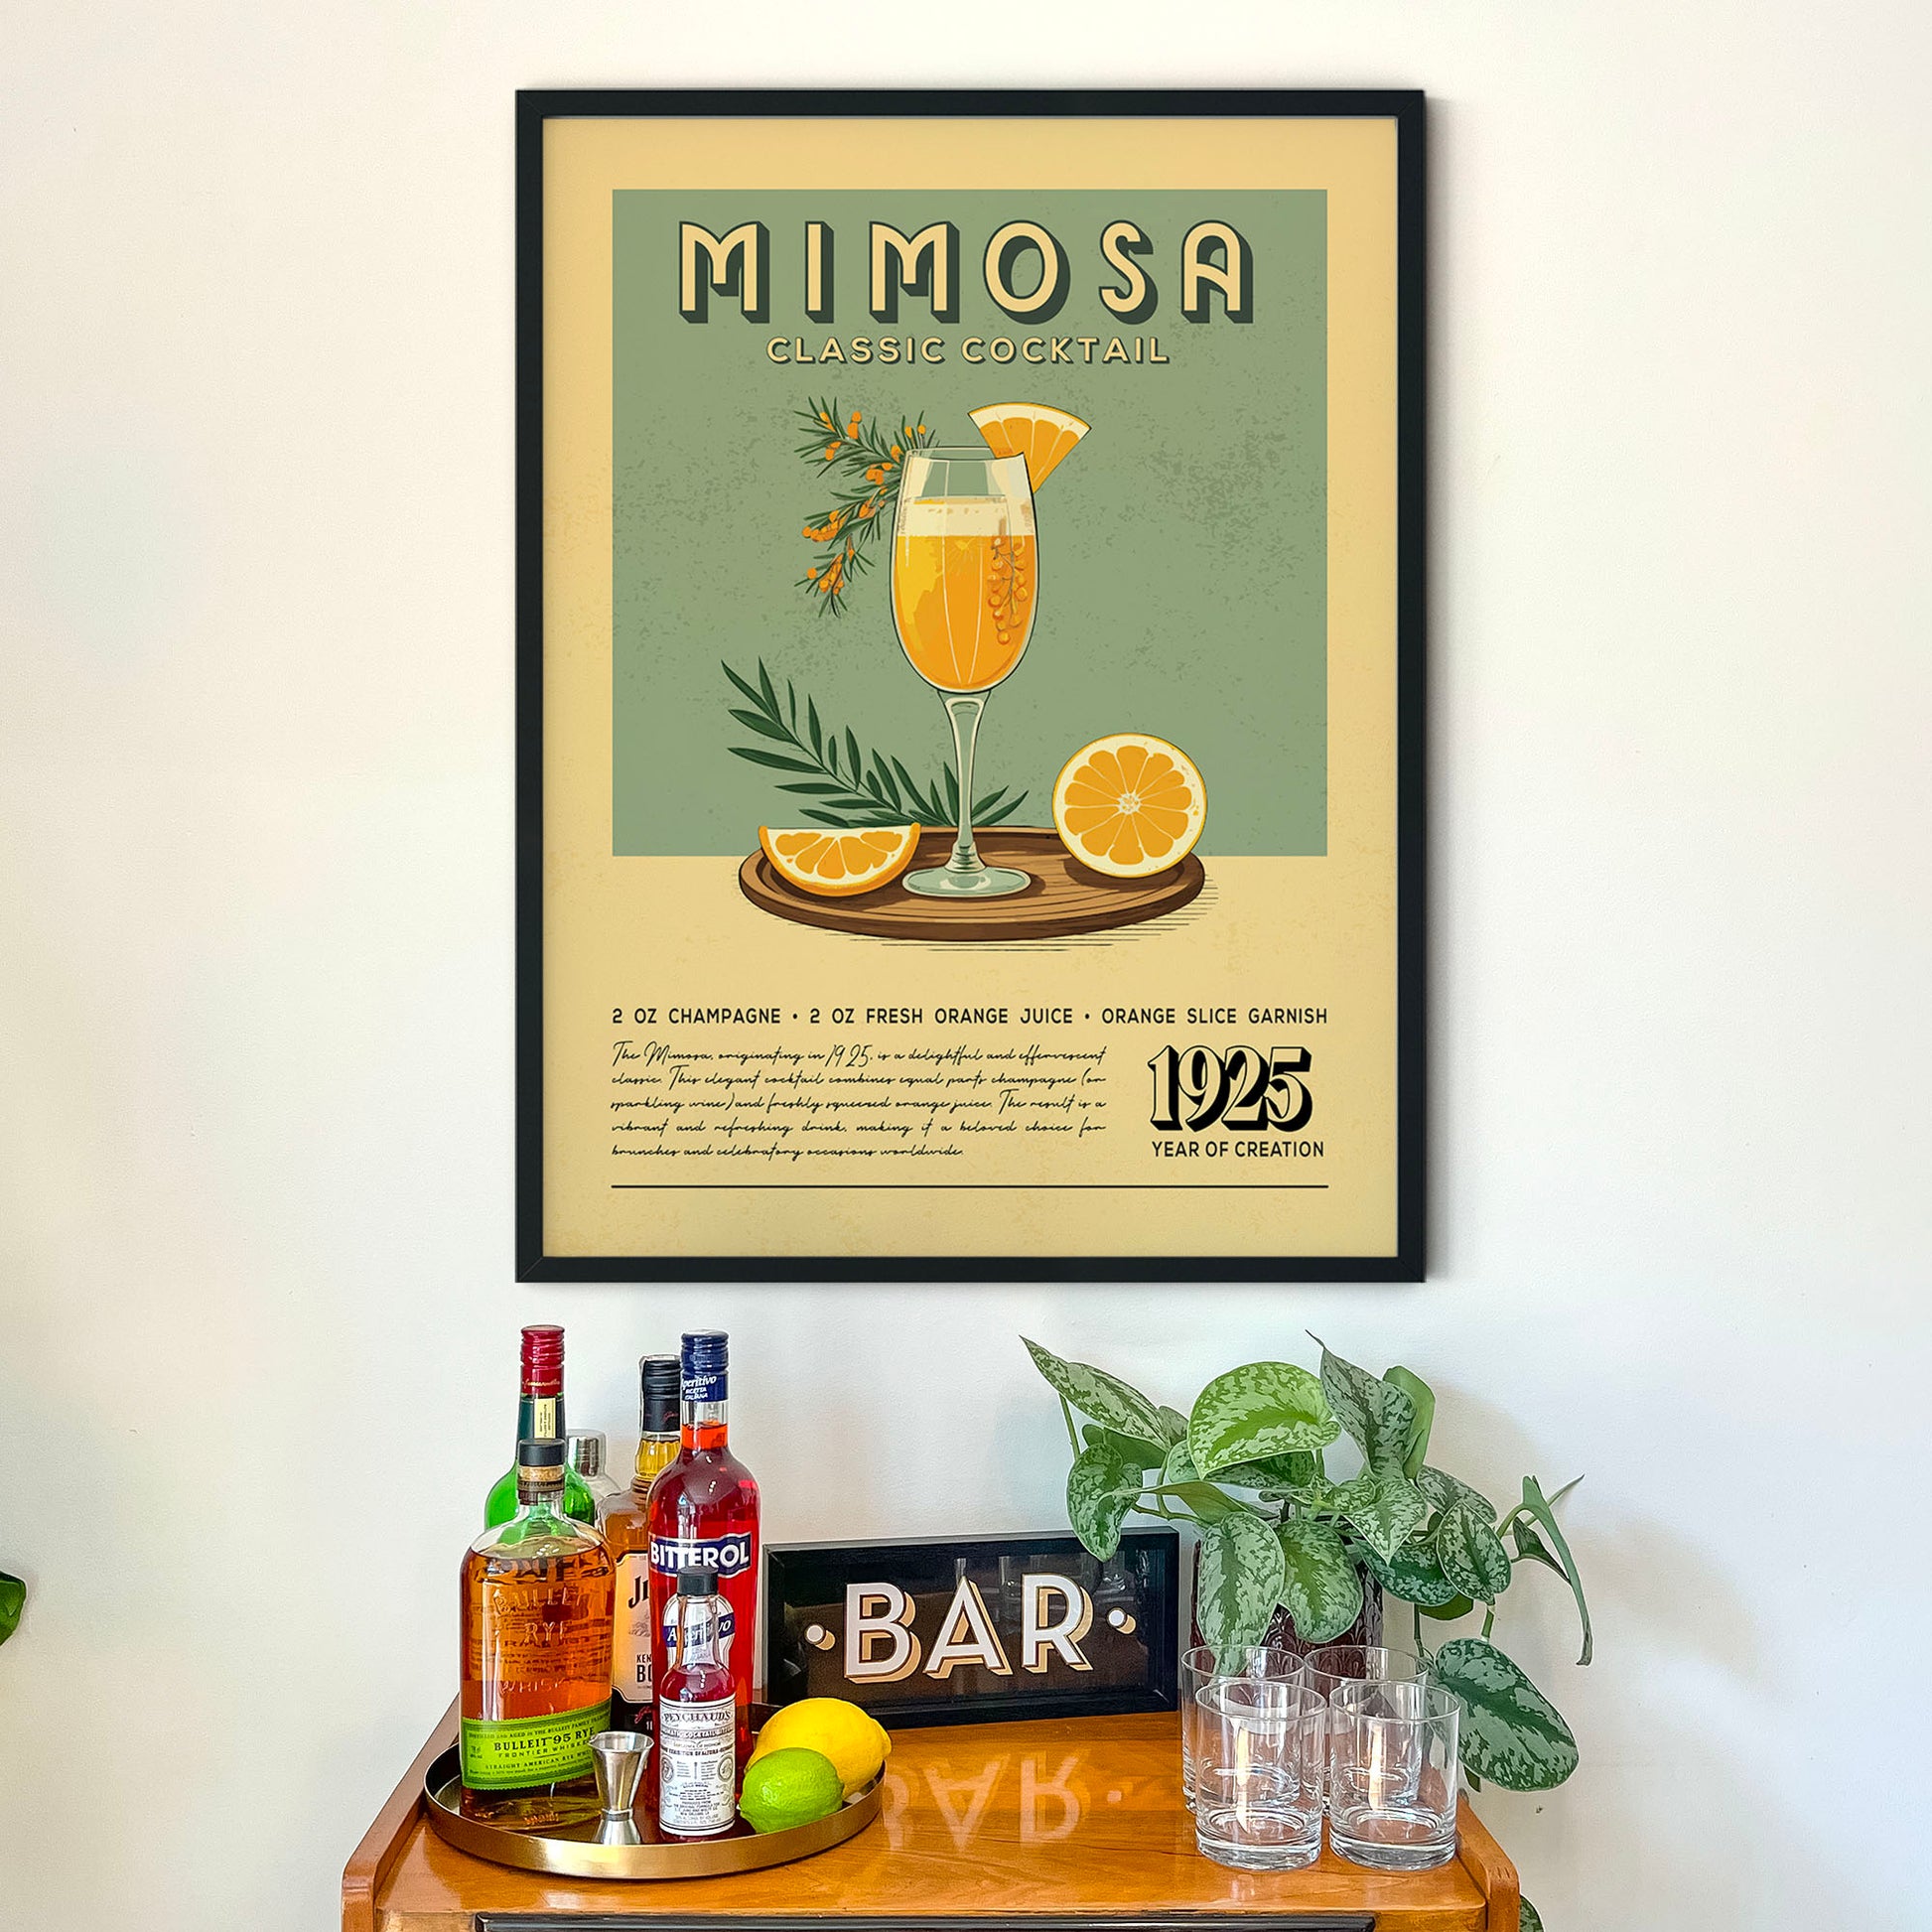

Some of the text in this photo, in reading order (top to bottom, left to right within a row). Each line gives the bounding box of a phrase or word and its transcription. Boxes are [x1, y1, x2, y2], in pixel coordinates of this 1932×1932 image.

[679, 219, 1254, 325] MIMOSA
[765, 336, 1170, 365] CLASSIC COCKTAIL
[612, 1008, 1327, 1025] 2 OZ CHAMPAGNE 2 OZ FRESH ORANGE JUICE ORANGE SLICE GARNISH
[612, 1040, 640, 1067] The
[718, 1045, 804, 1066] originating
[807, 1051, 826, 1060] in
[877, 1051, 892, 1061] is
[907, 1044, 983, 1066] delightful
[986, 1047, 1017, 1060] and
[1018, 1043, 1107, 1066] effervescent
[612, 1063, 1107, 1090] classic. This elegant cocktail combines equal parts champagne (or
[1148, 1045, 1313, 1133] 1925
[610, 1096, 685, 1114] sparkling
[734, 1096, 765, 1108] and
[766, 1092, 824, 1114] freshly
[825, 1095, 893, 1114] squeezed
[895, 1101, 950, 1115] orange
[948, 1099, 993, 1115] juice.
[998, 1088, 1028, 1115] The
[1030, 1093, 1076, 1114] result
[1077, 1099, 1092, 1109] is
[612, 1117, 669, 1138] vibrant
[675, 1120, 707, 1132] and
[714, 1116, 794, 1139] refreshing
[856, 1120, 913, 1139] making
[920, 1117, 934, 1138] it
[959, 1120, 1018, 1133] beloved
[1025, 1120, 1073, 1132] choice
[1078, 1116, 1107, 1138] for
[611, 1142, 964, 1163] brunches and celebratory occasions worldwide.
[1152, 1141, 1324, 1158] YEAR OF CREATION
[649, 1541, 751, 1570] BITTEROL
[844, 1572, 1094, 1685] BAR
[498, 1739, 590, 1758] FRONTIER WHISKE
[553, 1732, 571, 1745] 95
[575, 1726, 596, 1740] RYE
